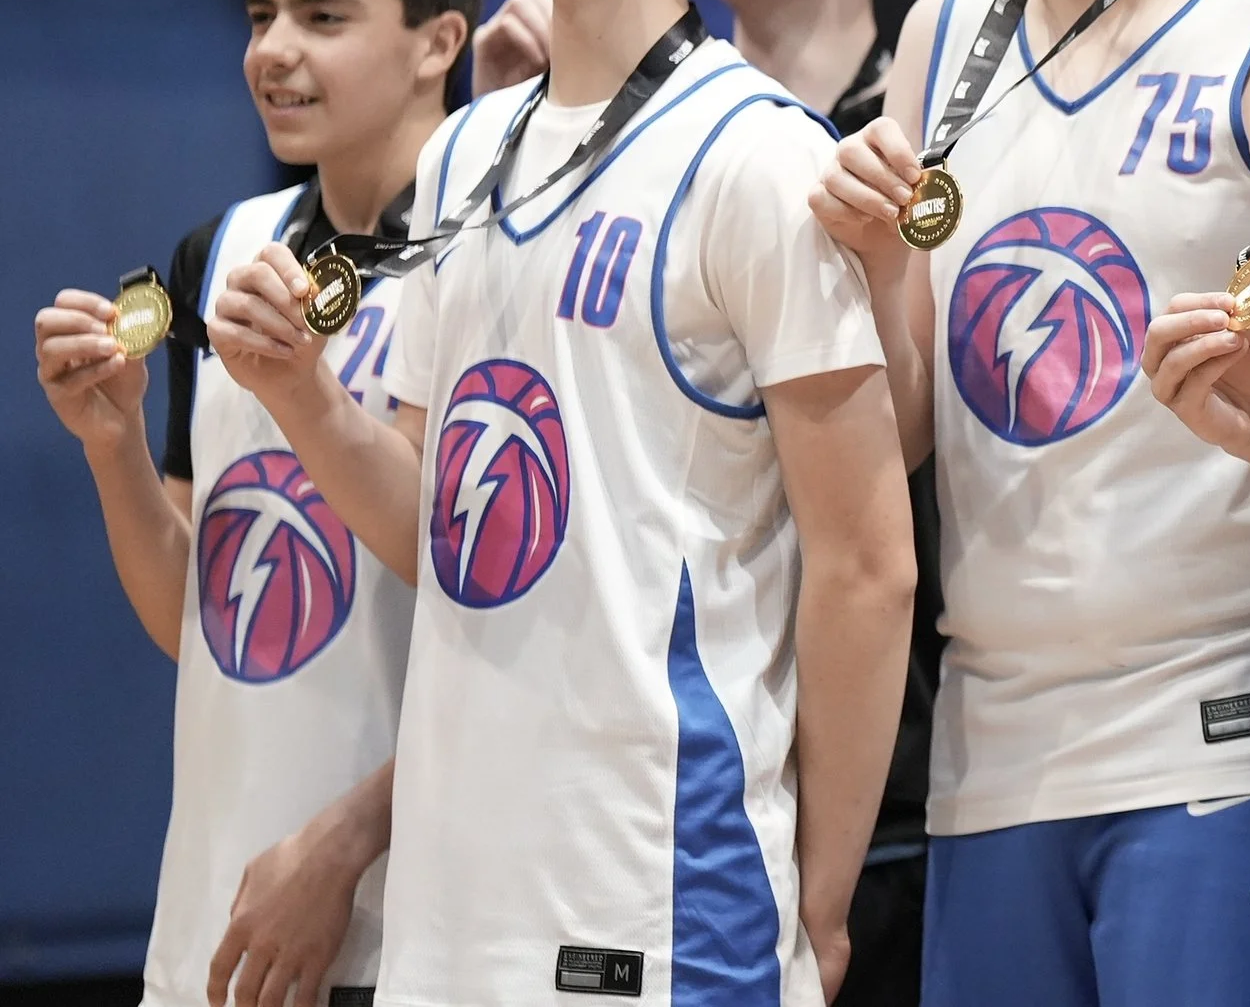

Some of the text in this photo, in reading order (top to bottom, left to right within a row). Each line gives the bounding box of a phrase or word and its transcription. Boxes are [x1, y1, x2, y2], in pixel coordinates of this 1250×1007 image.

[1118, 72, 1226, 176] 75
[556, 210, 643, 328] 10
[614, 962, 630, 983] M
